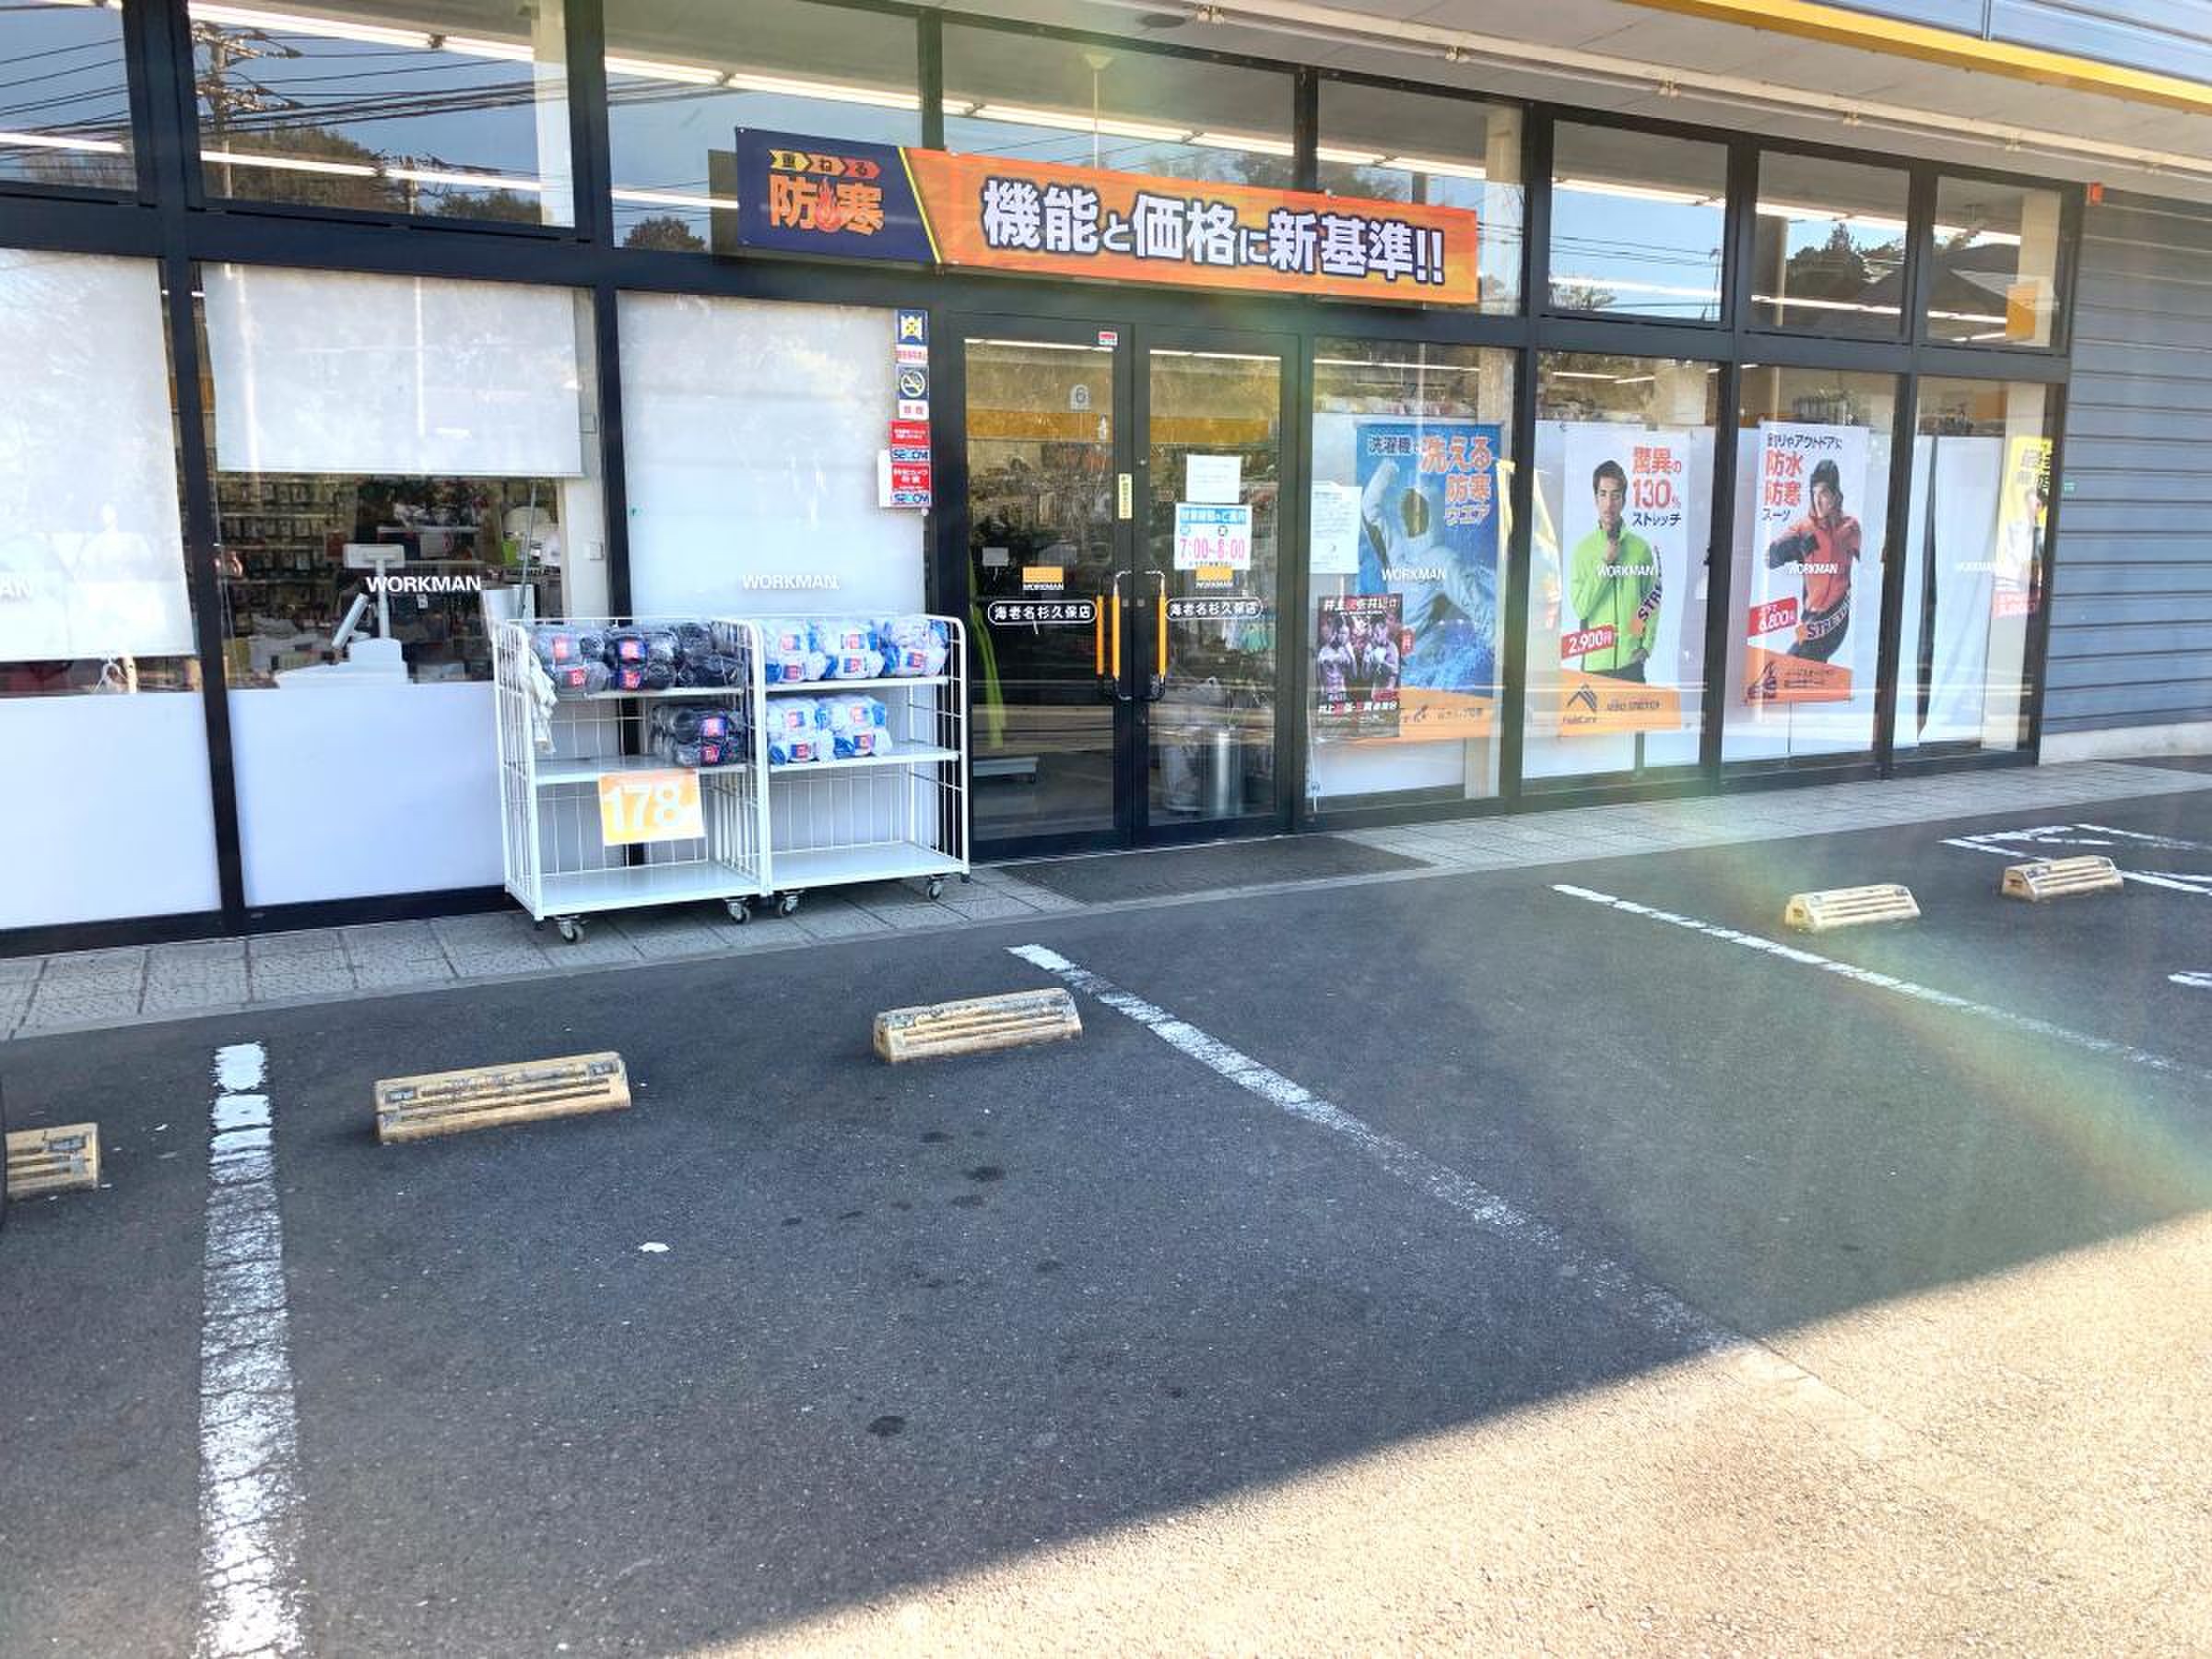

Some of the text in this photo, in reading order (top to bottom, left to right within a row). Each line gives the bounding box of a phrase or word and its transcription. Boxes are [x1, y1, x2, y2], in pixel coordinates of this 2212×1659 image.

[769, 174, 885, 236] 防寒
[1767, 450, 1803, 477] 防水
[1446, 474, 1490, 501] 防寒
[1766, 480, 1801, 507] 防寒
[1632, 512, 1681, 526] ストレッチ
[1597, 564, 1654, 576] WORKMAN
[366, 575, 482, 593] WORKMAN
[741, 574, 841, 590] WORKMAN
[994, 605, 1091, 619] 海老名杉久保店
[1170, 602, 1257, 618] 海老名杉久保店
[604, 782, 680, 831] 178
